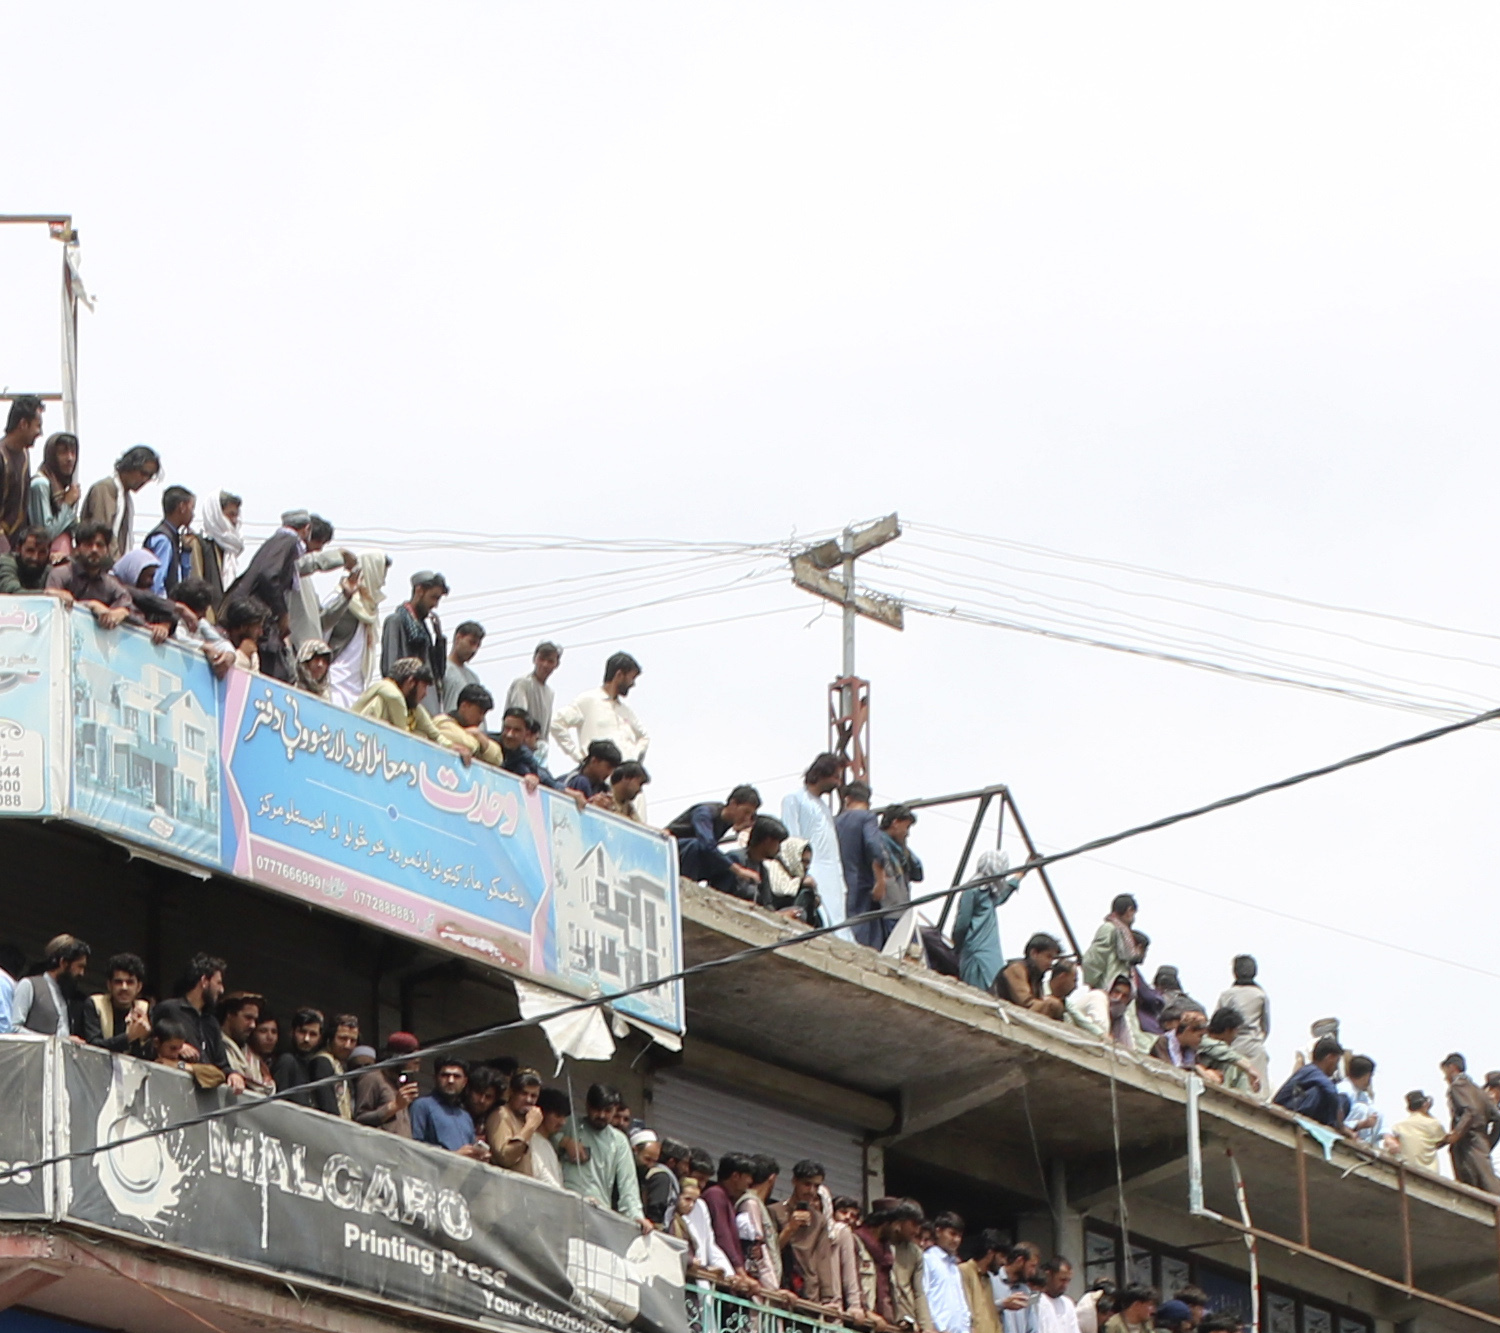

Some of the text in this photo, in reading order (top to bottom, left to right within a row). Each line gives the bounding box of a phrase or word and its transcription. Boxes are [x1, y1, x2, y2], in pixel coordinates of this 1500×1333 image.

[418, 760, 519, 836] وحدت
[343, 1222, 508, 1290] Printing Press
